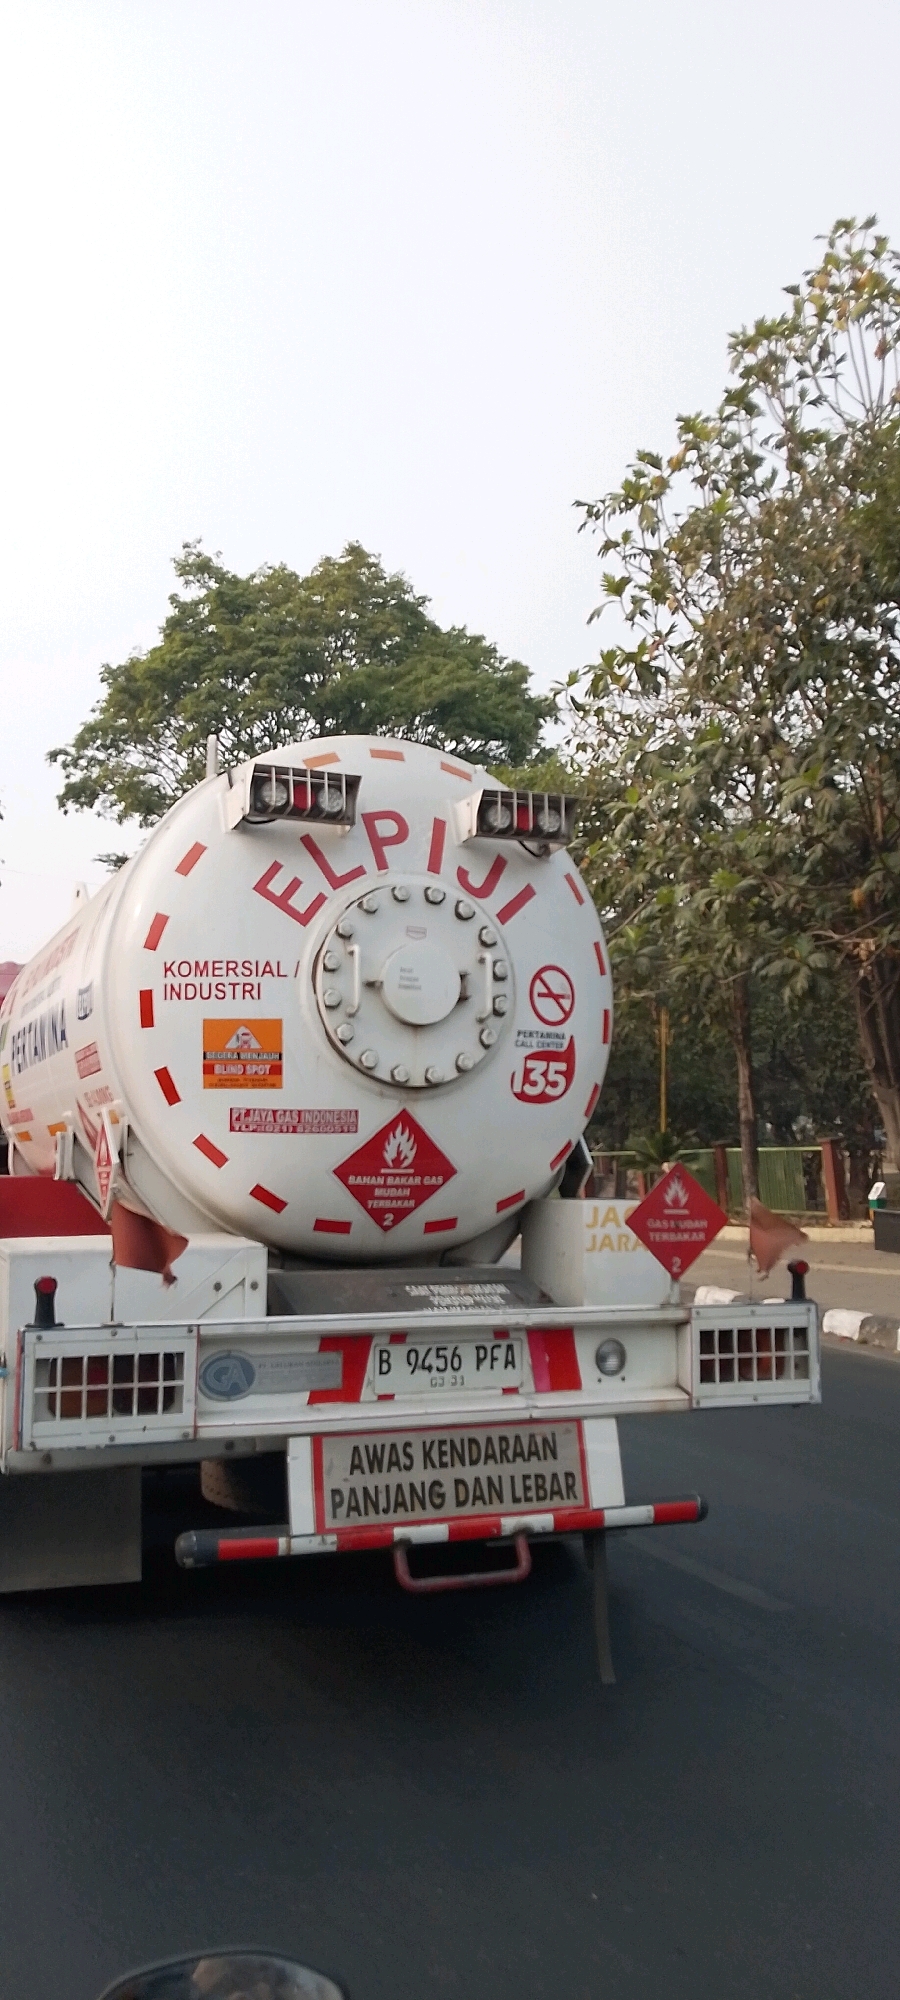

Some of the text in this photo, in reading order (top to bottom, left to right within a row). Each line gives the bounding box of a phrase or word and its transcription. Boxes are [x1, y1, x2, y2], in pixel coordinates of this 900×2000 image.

[253, 810, 536, 927] ELPIJI
[164, 960, 288, 978] KOMERSIAL
[164, 982, 261, 1000] INDUSTRI
[517, 1029, 566, 1040] PERTAMINA
[214, 1064, 271, 1075] BLIND SPOT
[513, 1057, 568, 1097] 135
[276, 1109, 299, 1123] GAS
[301, 1110, 357, 1123] INDONESIA
[348, 1175, 443, 1186] BAHAN BAKAR GAS
[374, 1187, 411, 1197] MUDAH
[367, 1200, 415, 1208] TERBAKAR
[383, 1212, 394, 1226] 2
[647, 1218, 669, 1229] GAS
[649, 1231, 706, 1242] TERBAKAR
[671, 1256, 682, 1273] 2
[379, 1344, 516, 1375] B 9456 PFA
[350, 1431, 558, 1476] AWAS KENDARAAN
[330, 1471, 578, 1519] PANJANG DAN LEBAR
